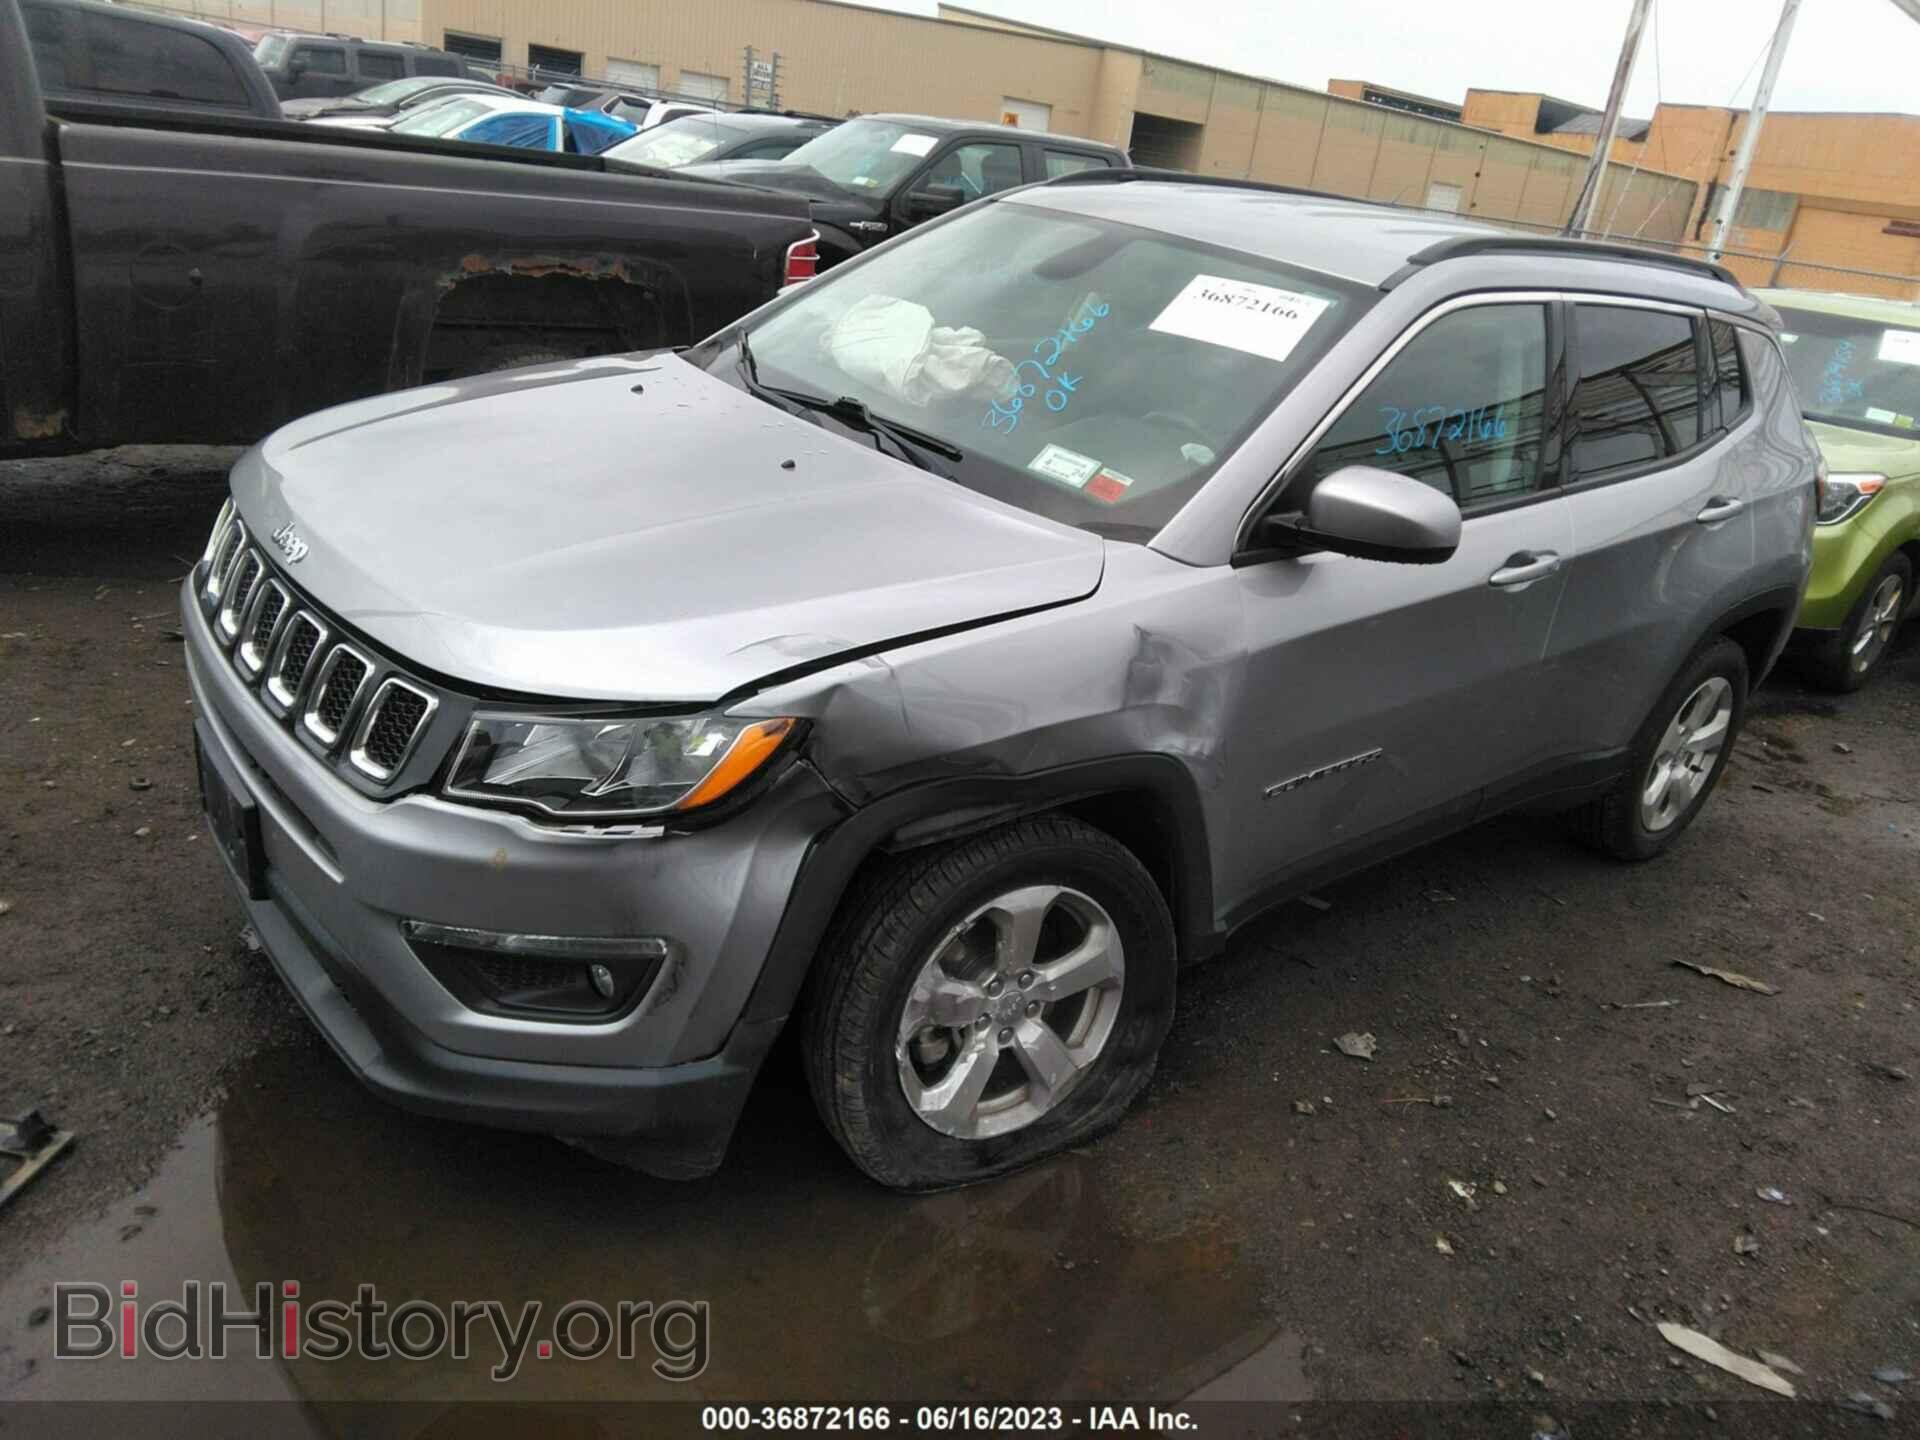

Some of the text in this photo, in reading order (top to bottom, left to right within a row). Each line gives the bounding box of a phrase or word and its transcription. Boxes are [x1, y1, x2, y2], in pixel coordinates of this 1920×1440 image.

[1193, 287, 1299, 321] 36872166
[1045, 372, 1083, 412] OK
[1375, 404, 1506, 455] 36872166
[272, 520, 310, 566] Jeep
